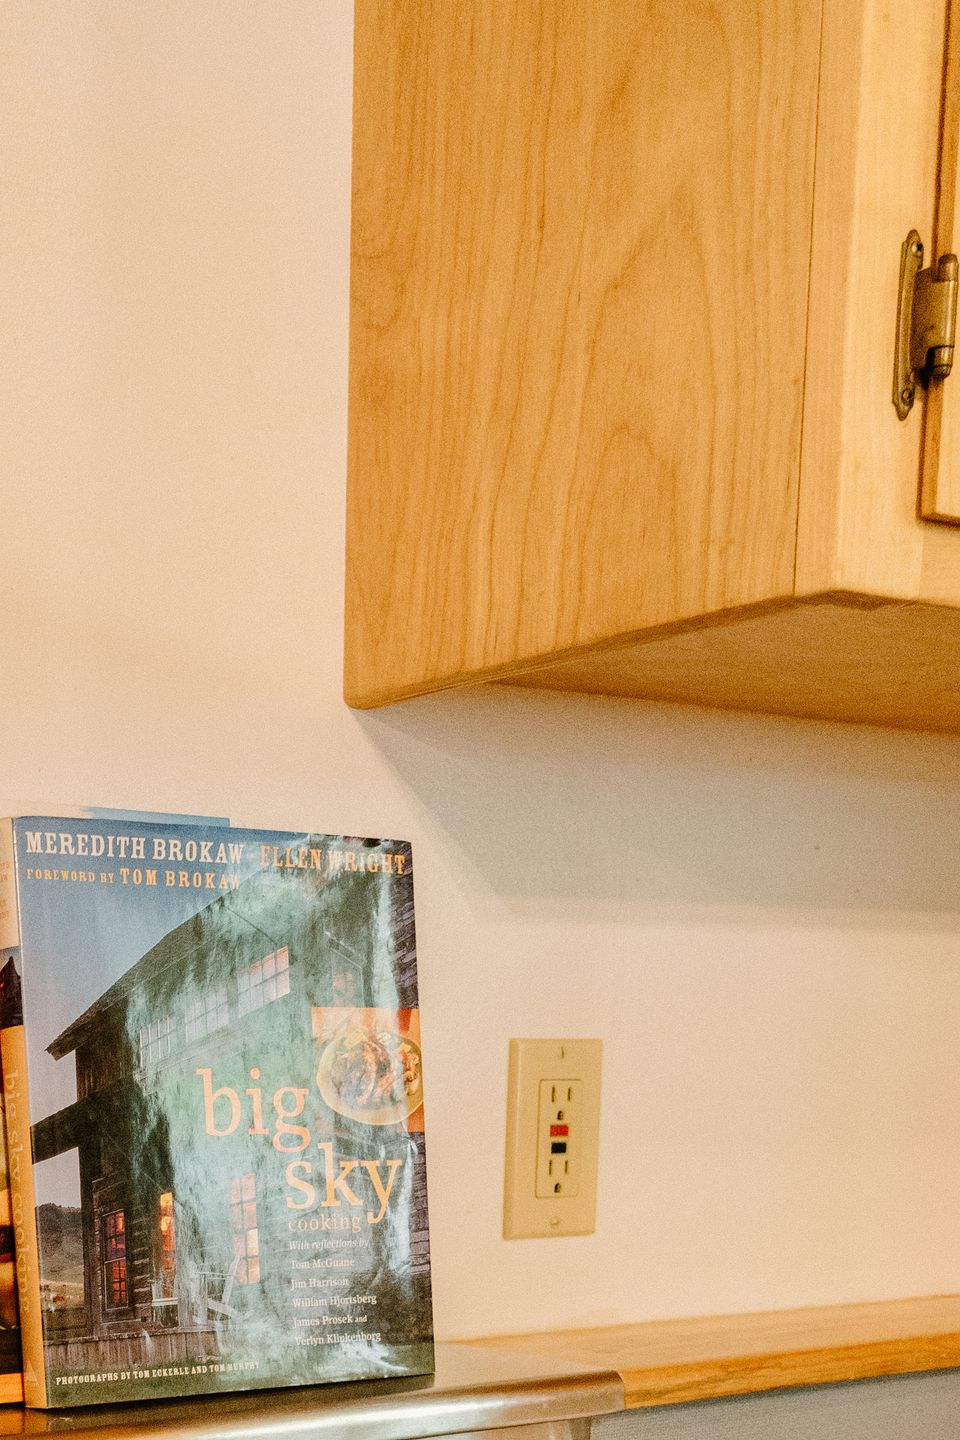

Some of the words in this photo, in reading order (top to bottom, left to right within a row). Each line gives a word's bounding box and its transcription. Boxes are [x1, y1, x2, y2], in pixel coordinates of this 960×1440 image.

[25, 831, 146, 859] MEREDITH
[152, 838, 245, 865] BROKAW
[261, 844, 322, 870] ELLEN
[327, 849, 406, 875] WRIGHT
[26, 868, 96, 883] FOREWORD
[100, 872, 115, 884] BY
[120, 867, 158, 886] TOM
[165, 870, 240, 889] BROKAW
[196, 1067, 311, 1153] big
[284, 1141, 403, 1225] sky
[287, 1213, 362, 1233] cooking
[288, 1240, 310, 1251] With
[358, 1238, 370, 1249] by
[289, 1260, 311, 1270] Tom
[329, 1294, 378, 1308] Hjortsberg
[293, 1317, 320, 1329] James
[321, 1314, 354, 1326] Prosek
[354, 1315, 368, 1324] and
[326, 1331, 381, 1345] Klinkenborg
[56, 1372, 120, 1386] PHOTOGRAPHS
[120, 1371, 132, 1381] BY
[133, 1370, 150, 1380] TOM
[152, 1367, 190, 1378] ECKERLE
[191, 1365, 208, 1375] AND
[209, 1364, 225, 1373] TOM
